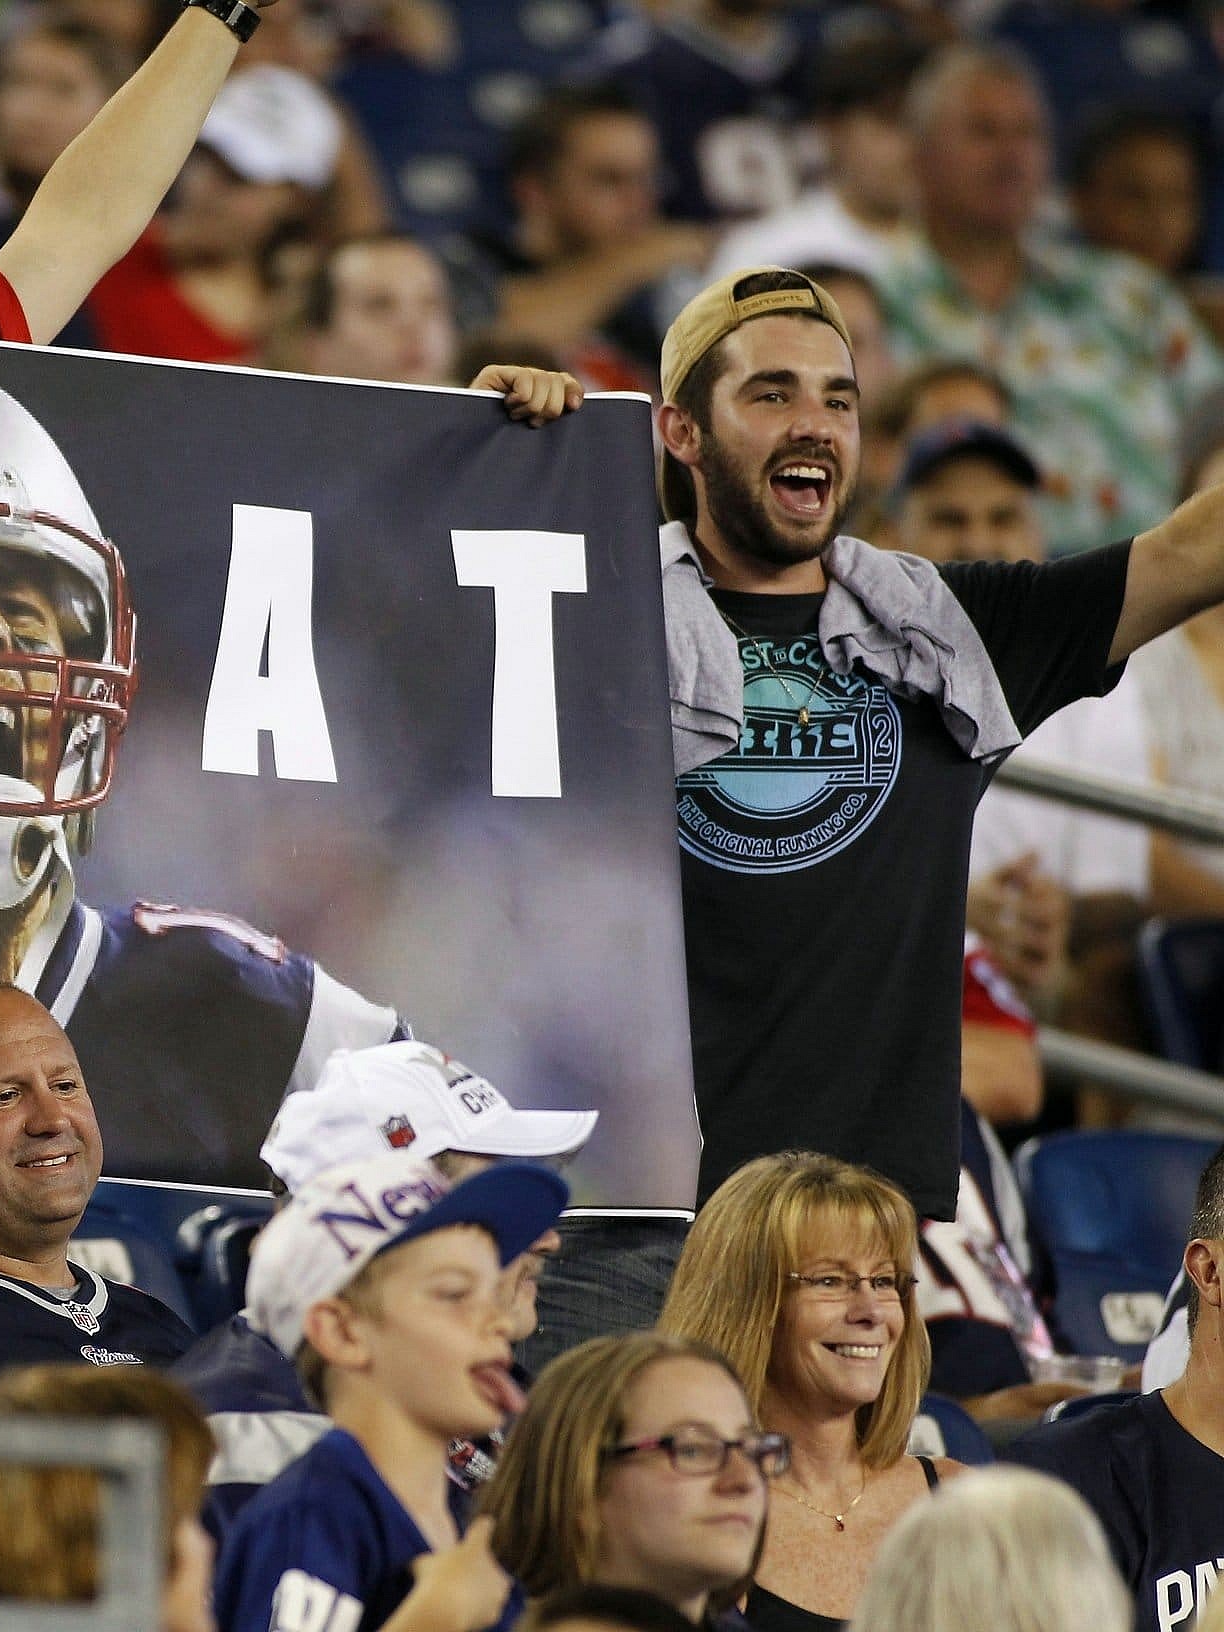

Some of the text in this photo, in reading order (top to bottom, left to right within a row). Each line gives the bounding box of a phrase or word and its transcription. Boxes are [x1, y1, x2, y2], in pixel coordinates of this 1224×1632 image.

[677, 791, 869, 858] THE ORIGINAL RUNNING CO.
